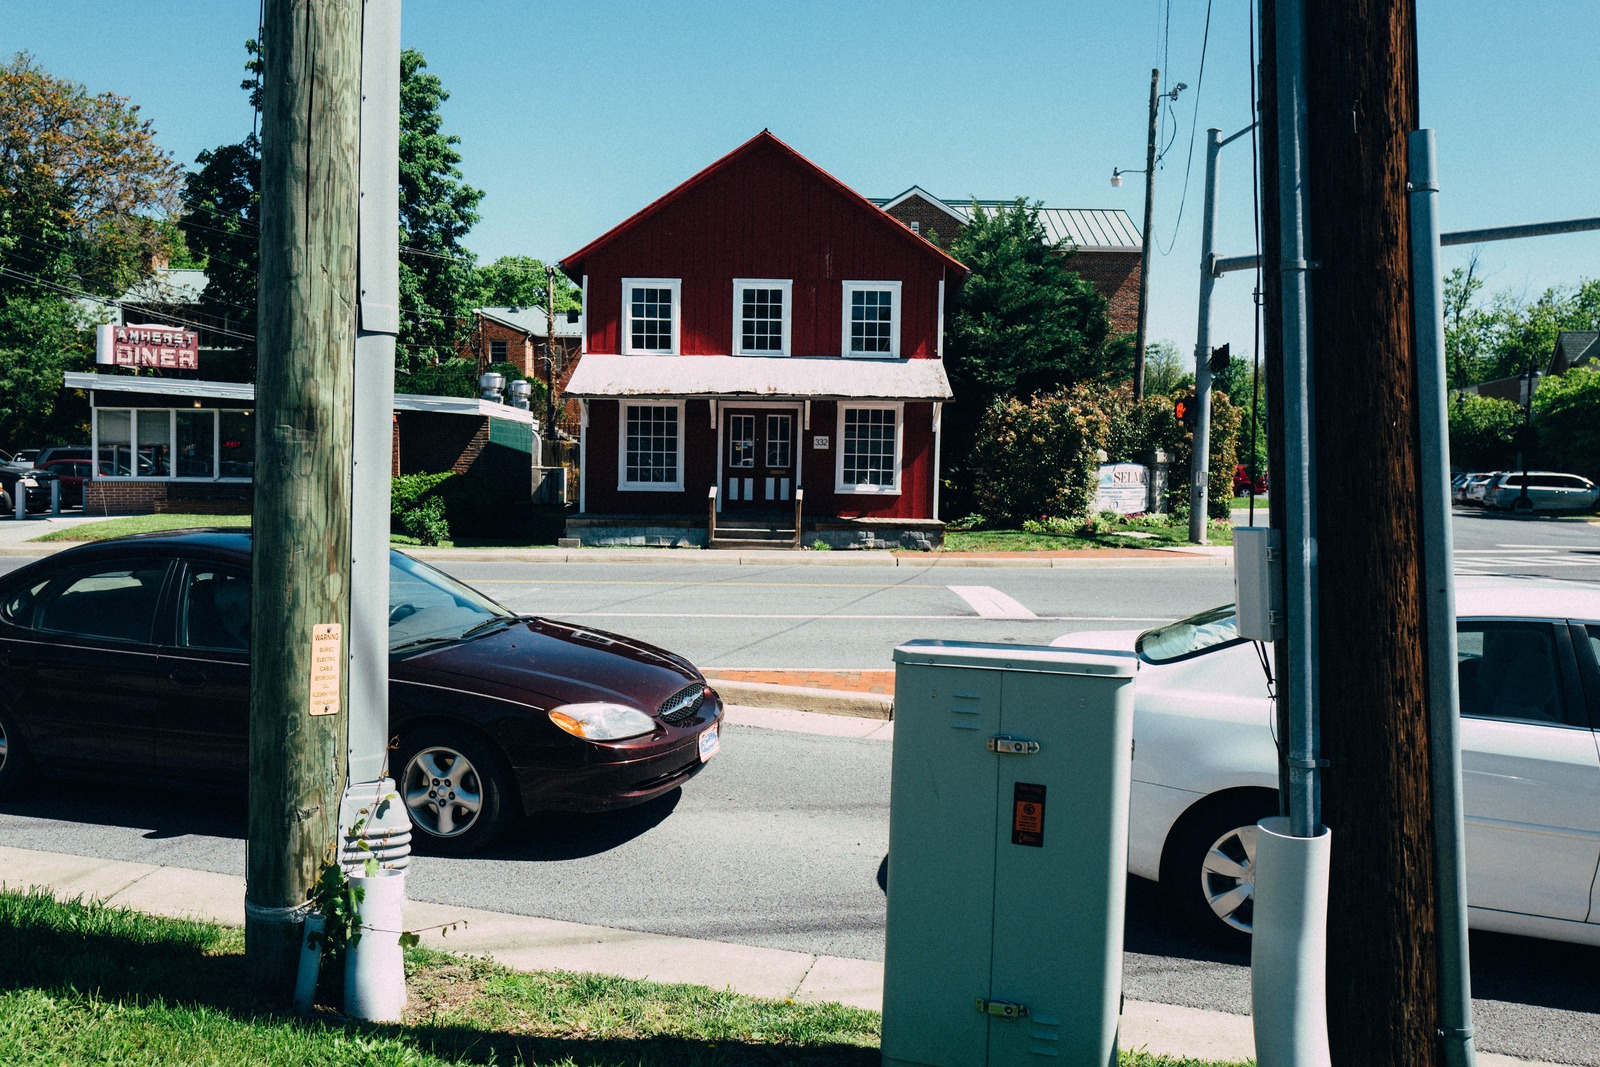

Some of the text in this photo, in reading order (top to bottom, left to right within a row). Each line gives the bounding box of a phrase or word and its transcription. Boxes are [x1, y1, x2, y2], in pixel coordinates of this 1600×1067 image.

[117, 329, 195, 345] AMHERST
[116, 346, 195, 367] DINER
[815, 438, 828, 446] 332
[1113, 471, 1149, 484] SELMA
[315, 633, 338, 641] WARNING
